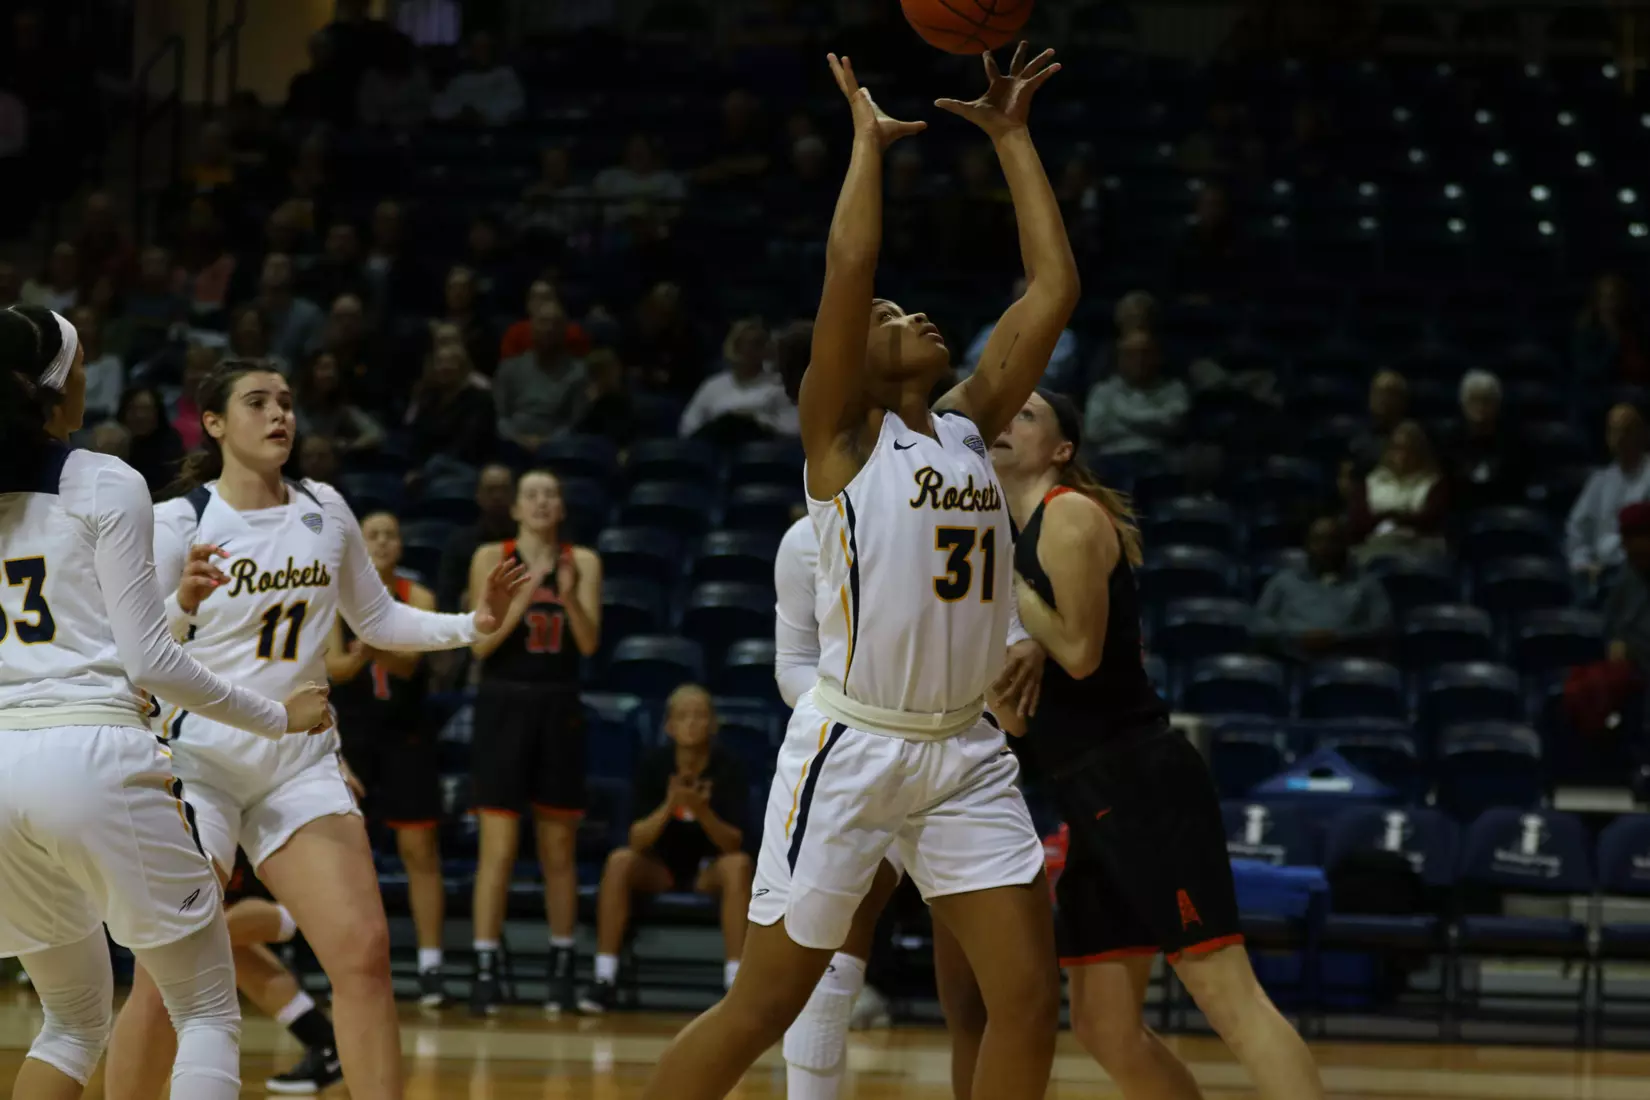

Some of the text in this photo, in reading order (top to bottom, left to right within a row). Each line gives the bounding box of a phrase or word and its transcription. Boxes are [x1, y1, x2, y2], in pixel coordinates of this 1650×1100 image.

[229, 556, 331, 597] Rockets
[932, 525, 996, 604] 31
[0, 555, 56, 646] 3
[256, 601, 308, 661] 11
